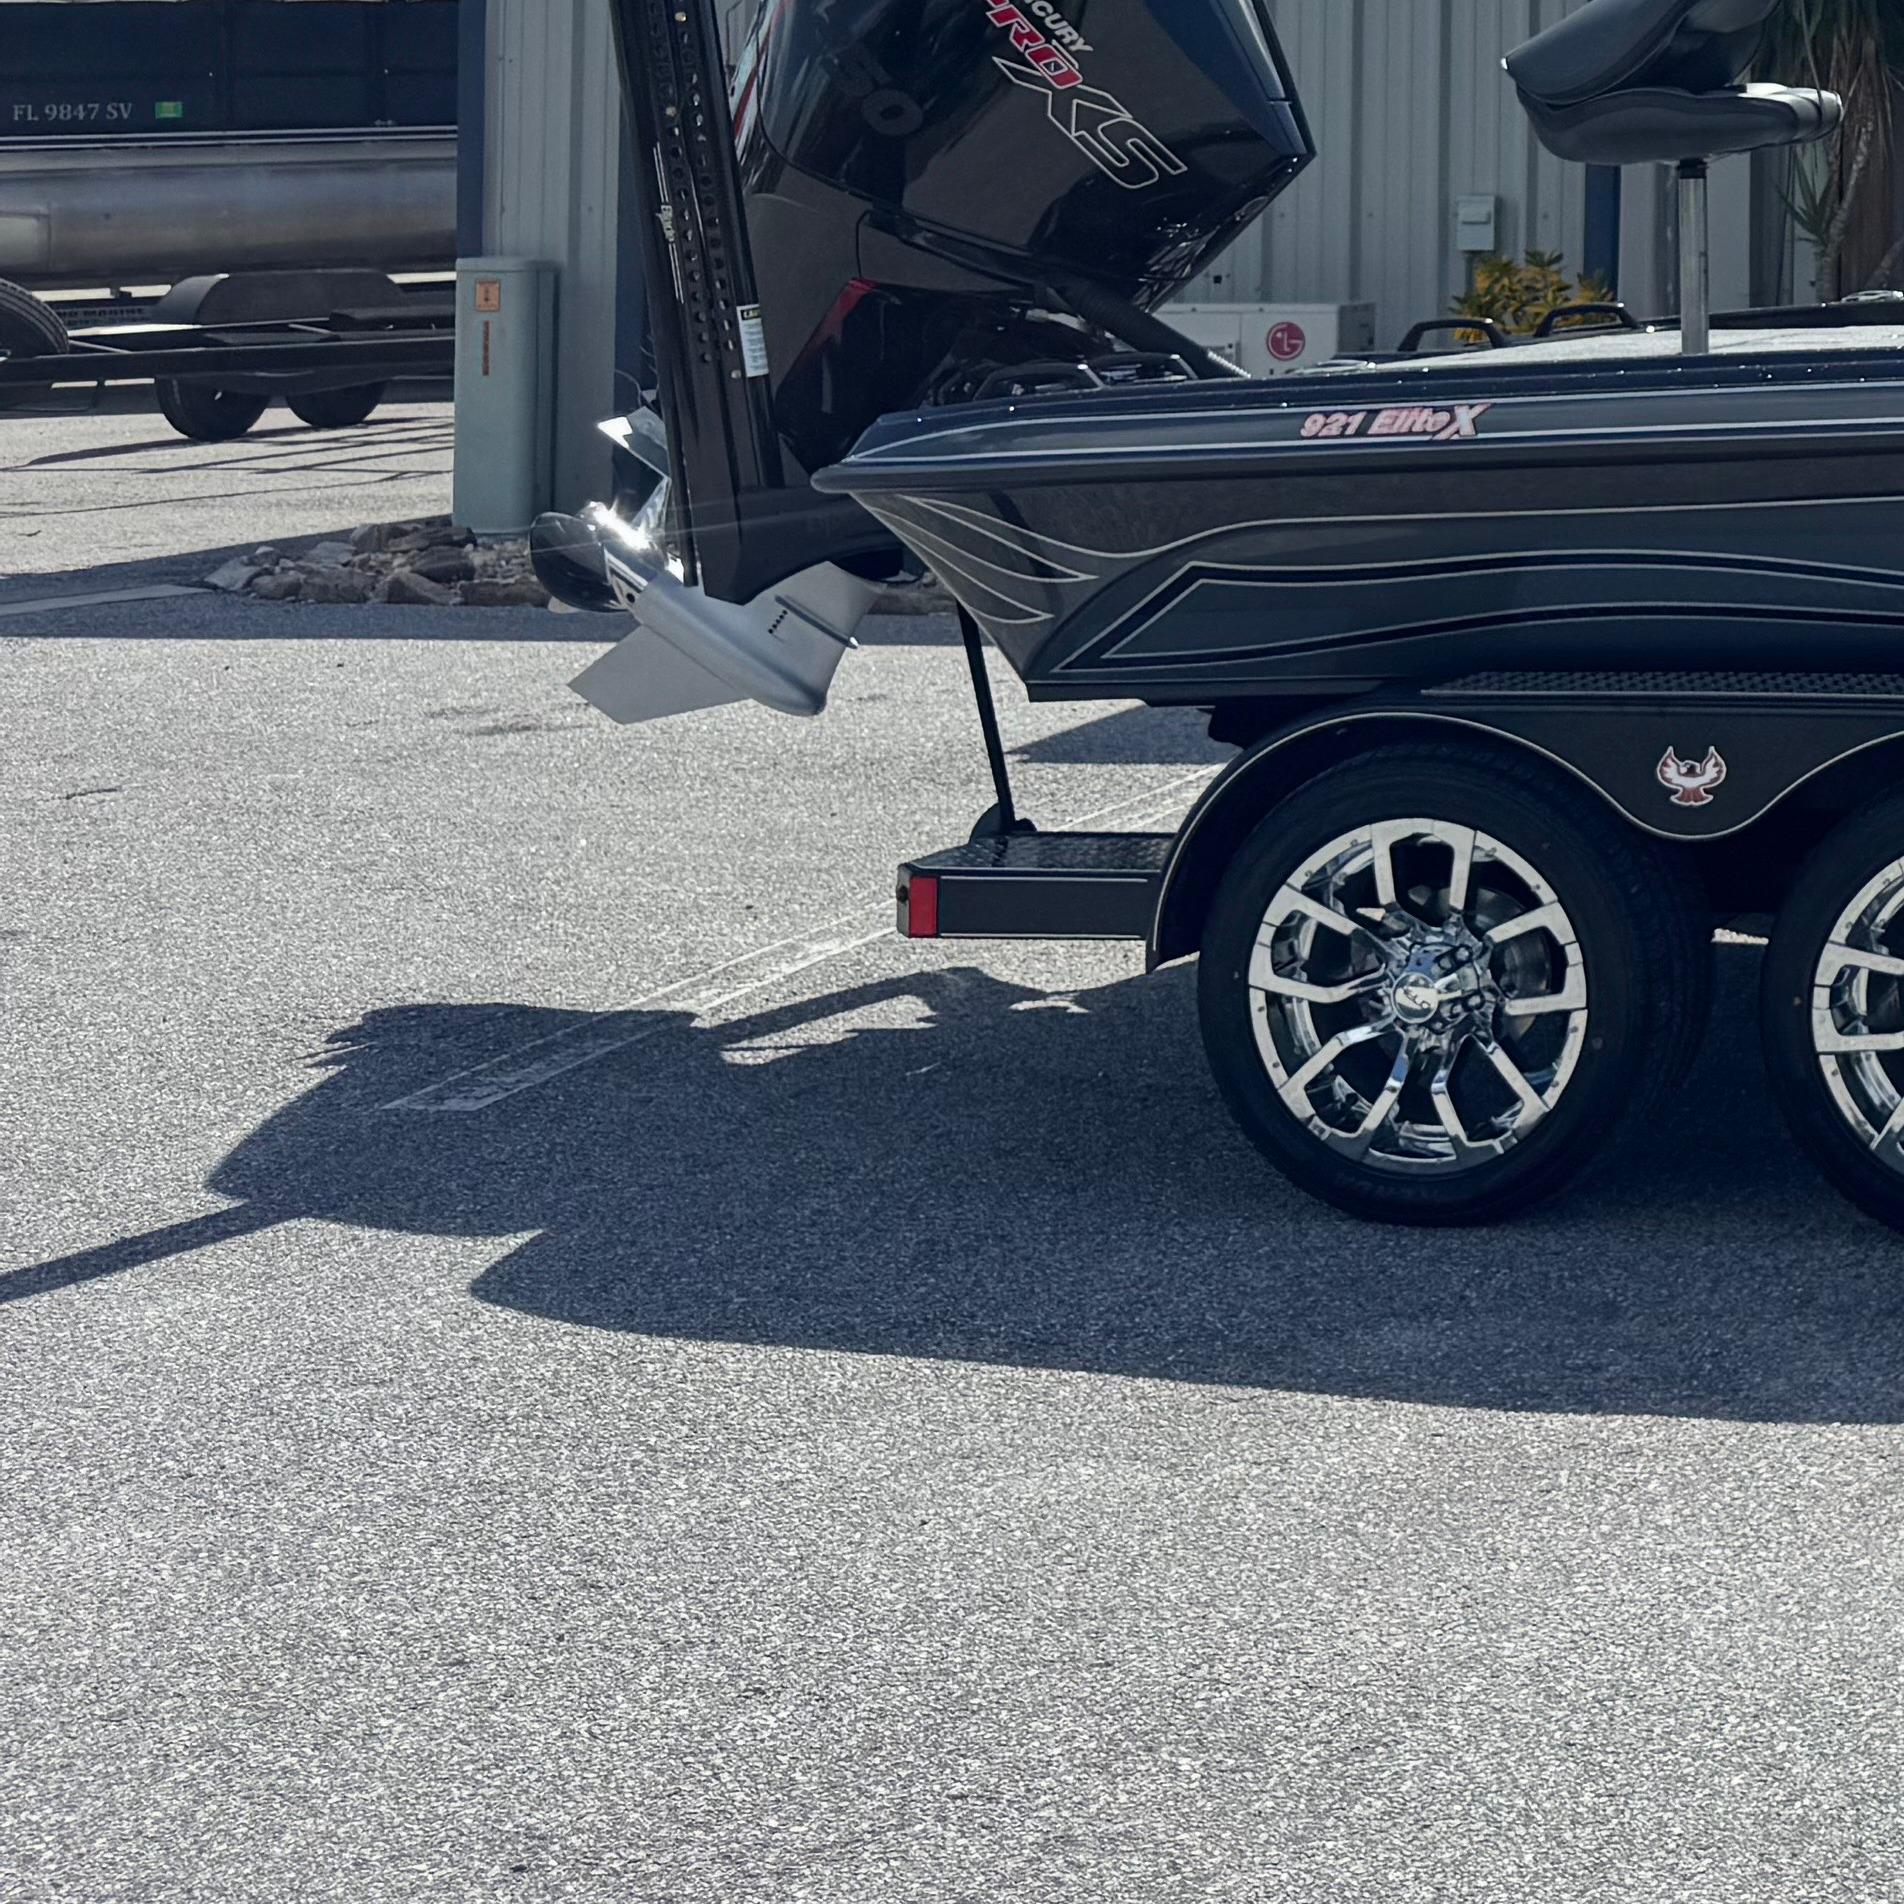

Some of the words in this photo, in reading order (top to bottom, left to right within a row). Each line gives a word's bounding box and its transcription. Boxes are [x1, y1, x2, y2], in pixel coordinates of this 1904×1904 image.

[13, 104, 39, 121] FL
[44, 103, 100, 121] 9847
[106, 102, 133, 120] SV
[992, 40, 1188, 188] XS
[1301, 411, 1367, 438] 921
